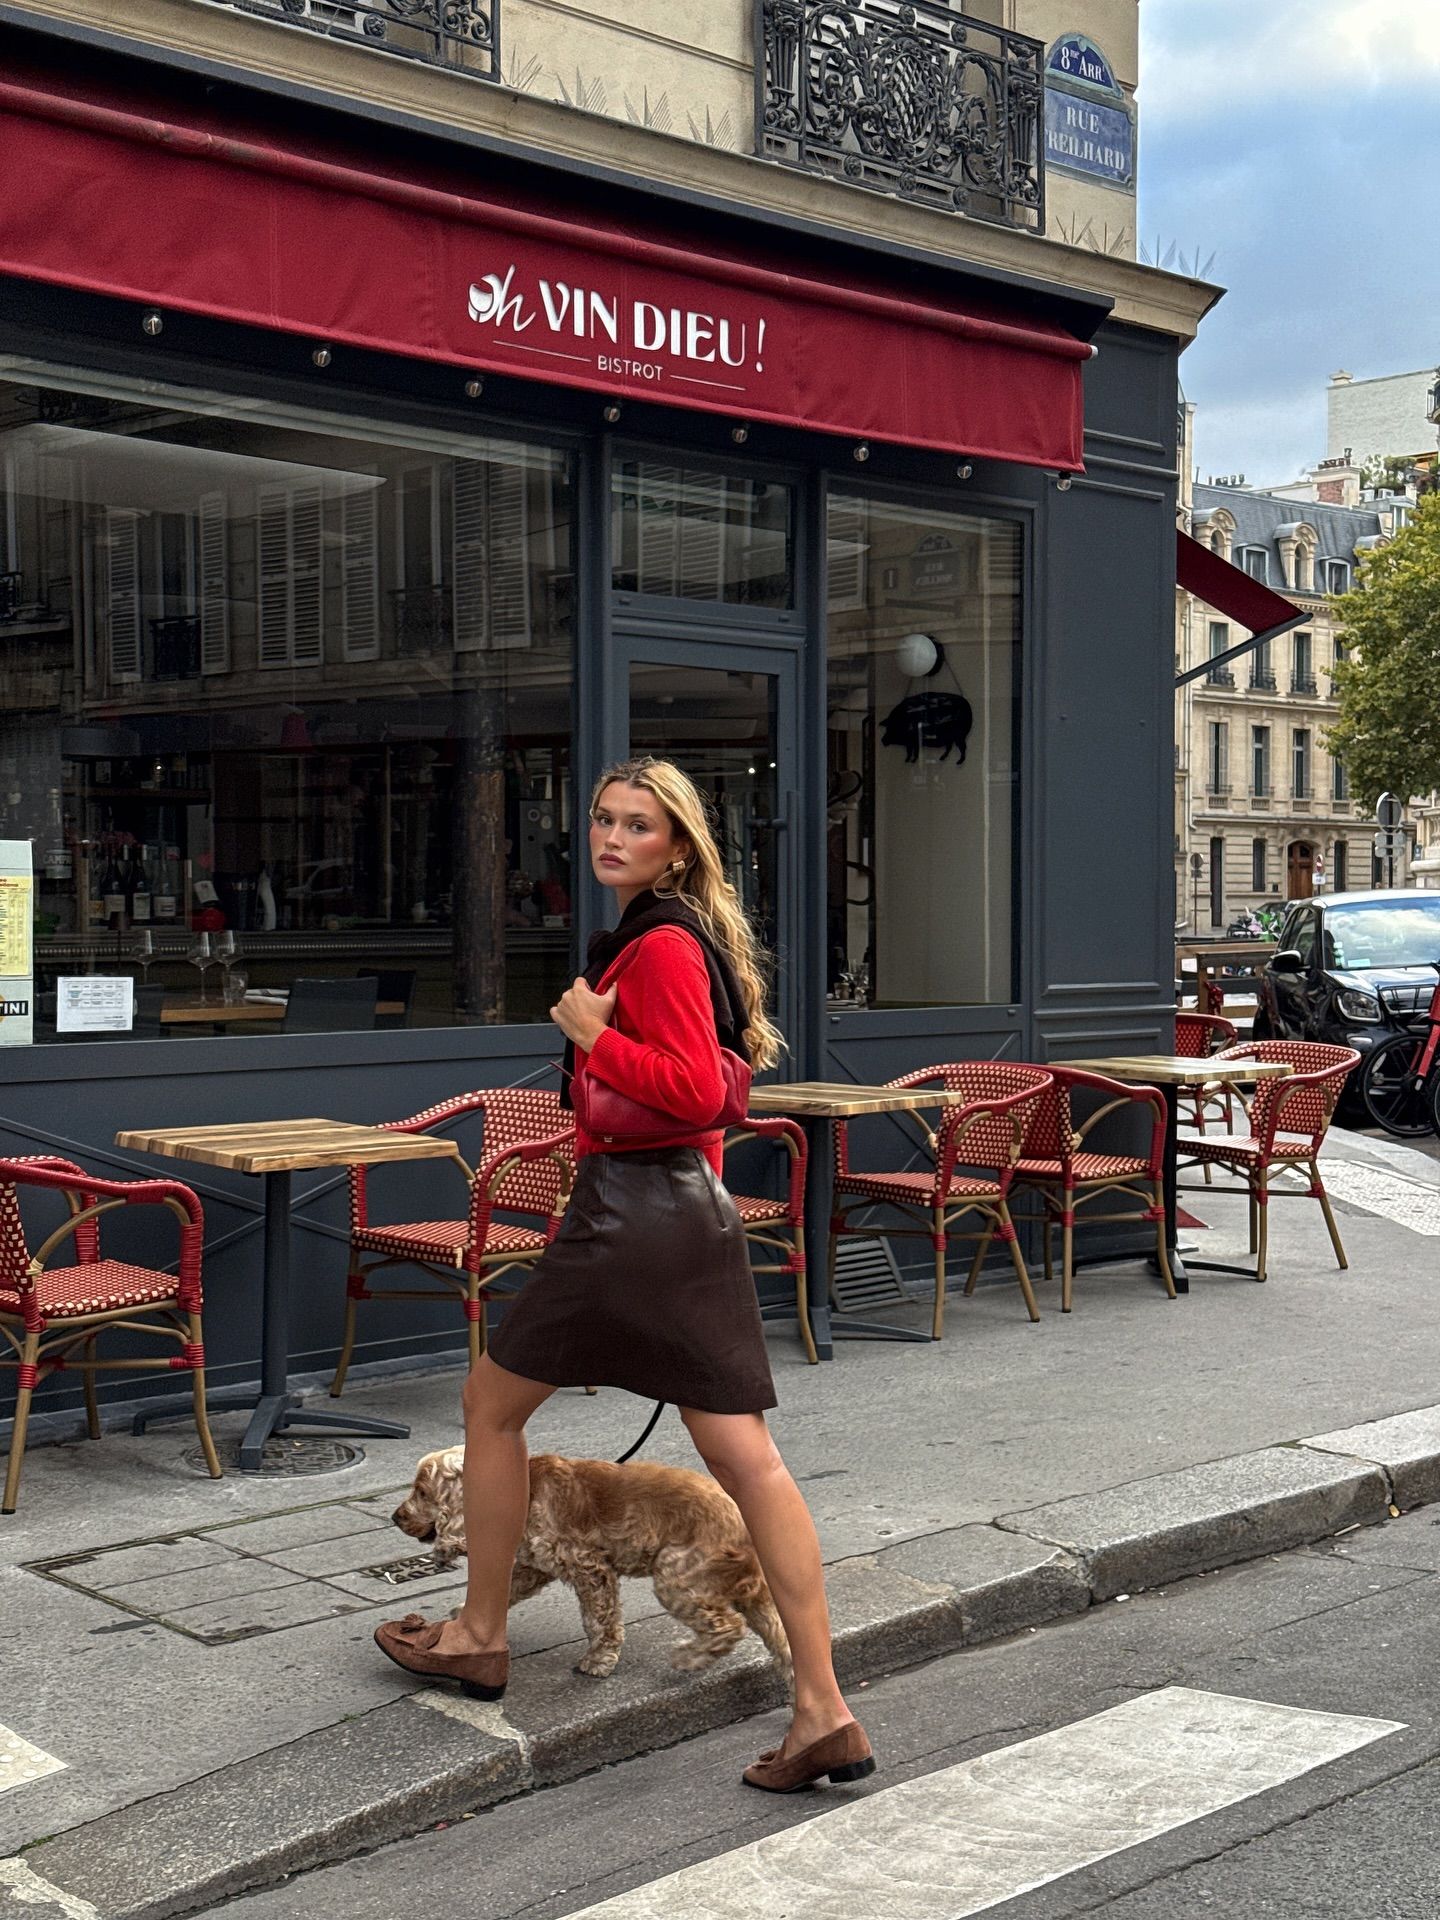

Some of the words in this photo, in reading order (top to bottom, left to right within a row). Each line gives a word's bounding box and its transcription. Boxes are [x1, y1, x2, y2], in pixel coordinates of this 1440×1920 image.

[1066, 106, 1099, 134] RUE
[1045, 129, 1125, 170] REILHARD
[538, 279, 617, 344] VIN
[597, 354, 664, 381] BISTROT
